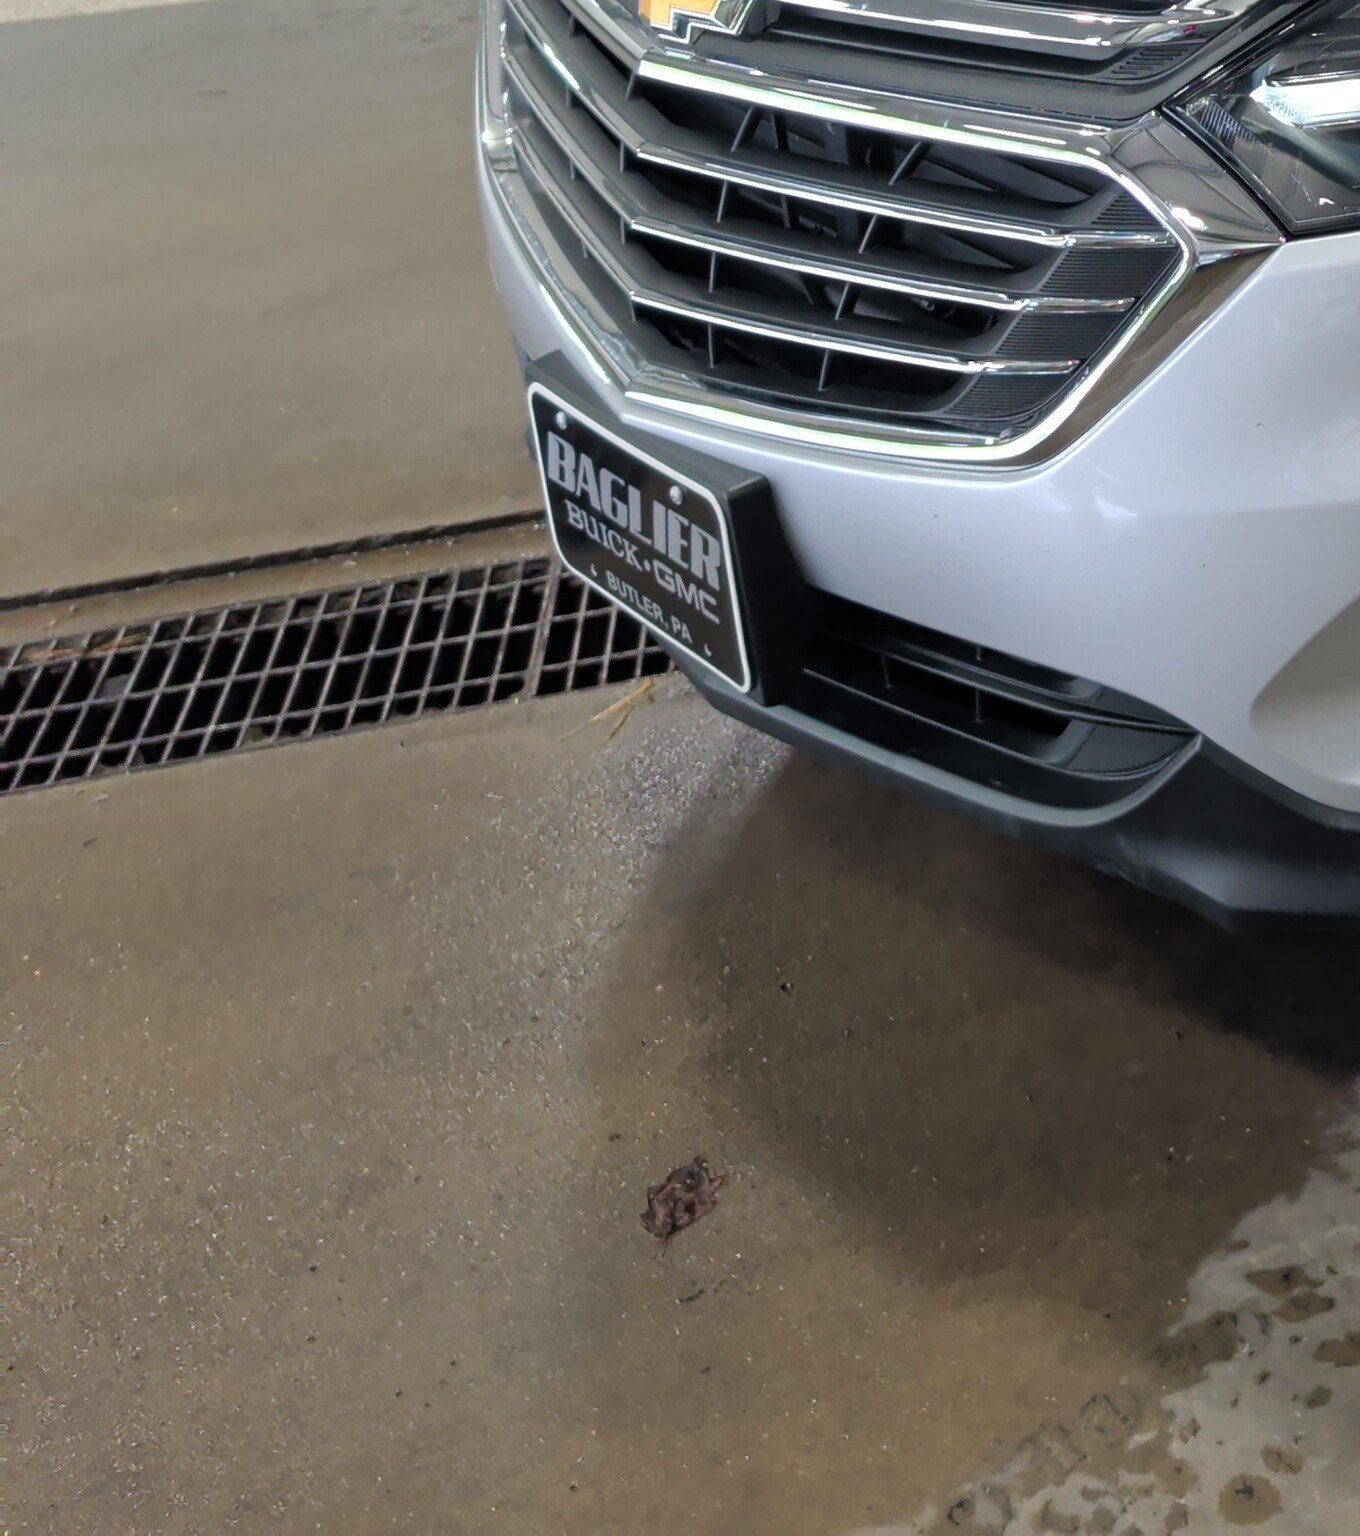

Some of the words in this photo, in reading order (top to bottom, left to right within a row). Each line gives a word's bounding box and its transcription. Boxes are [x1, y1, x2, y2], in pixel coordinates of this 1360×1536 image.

[547, 431, 723, 591] BAGLIER
[564, 499, 645, 571] BUICK
[653, 560, 721, 625] GMC
[671, 615, 694, 645] PA
